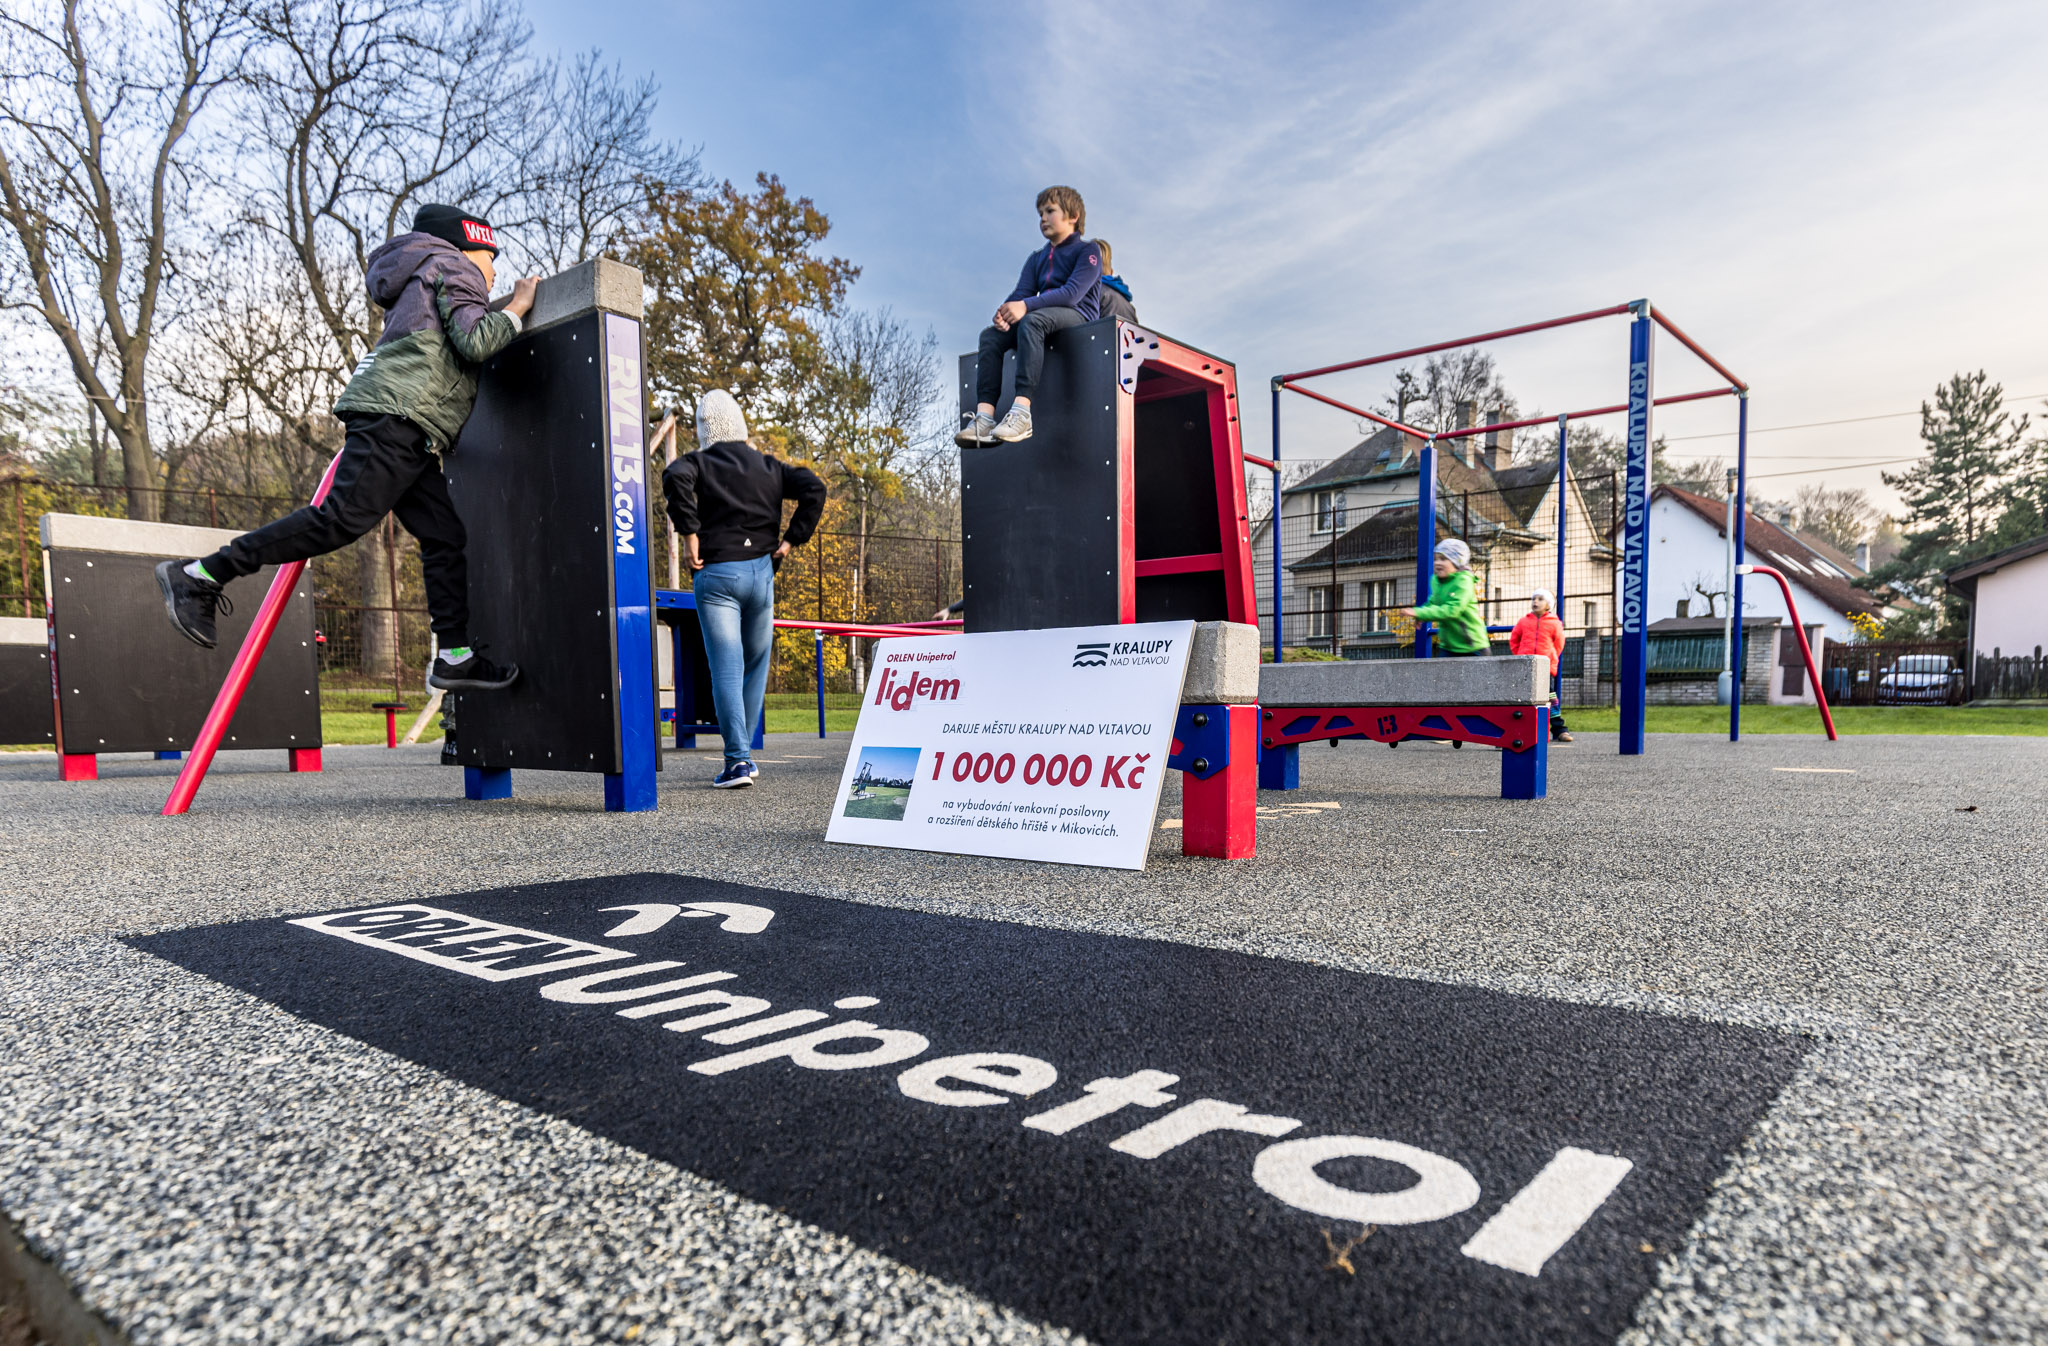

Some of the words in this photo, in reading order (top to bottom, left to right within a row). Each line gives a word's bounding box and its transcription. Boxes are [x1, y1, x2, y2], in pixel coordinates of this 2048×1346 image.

[1628, 362, 1647, 469] KRALUPY
[609, 354, 642, 554] RVL13.COM
[1626, 476, 1644, 527] NAD
[1624, 532, 1643, 633] VLTAVOU
[887, 653, 915, 662] ORLEN
[916, 650, 957, 663] Unipetrol
[1110, 658, 1129, 666] NAD
[1132, 656, 1170, 666] VLTAVOU
[1113, 640, 1173, 655] KRALUPY
[875, 668, 960, 711] lidem
[942, 723, 980, 734] DARUJE
[981, 720, 1016, 734] MĚSTU
[1018, 723, 1066, 735] KRALUPY
[1068, 723, 1095, 735] NAD
[1099, 723, 1151, 735] VLTAVOU
[932, 752, 945, 780] 1
[952, 752, 1016, 784] 000
[1023, 753, 1092, 787] 000
[1100, 752, 1151, 789] Kč
[936, 814, 975, 827] rozšíření
[976, 816, 1019, 830] dětského
[1021, 818, 1048, 832] hřiště
[1051, 824, 1057, 832] v
[1059, 822, 1120, 837] Mikovicích.
[942, 801, 954, 809] na
[957, 798, 1012, 812] vybudování
[1013, 802, 1057, 815] venkovní
[1059, 804, 1111, 821] posilovny
[322, 910, 600, 970] ORLEN
[540, 961, 1633, 1276] Unipetrol
